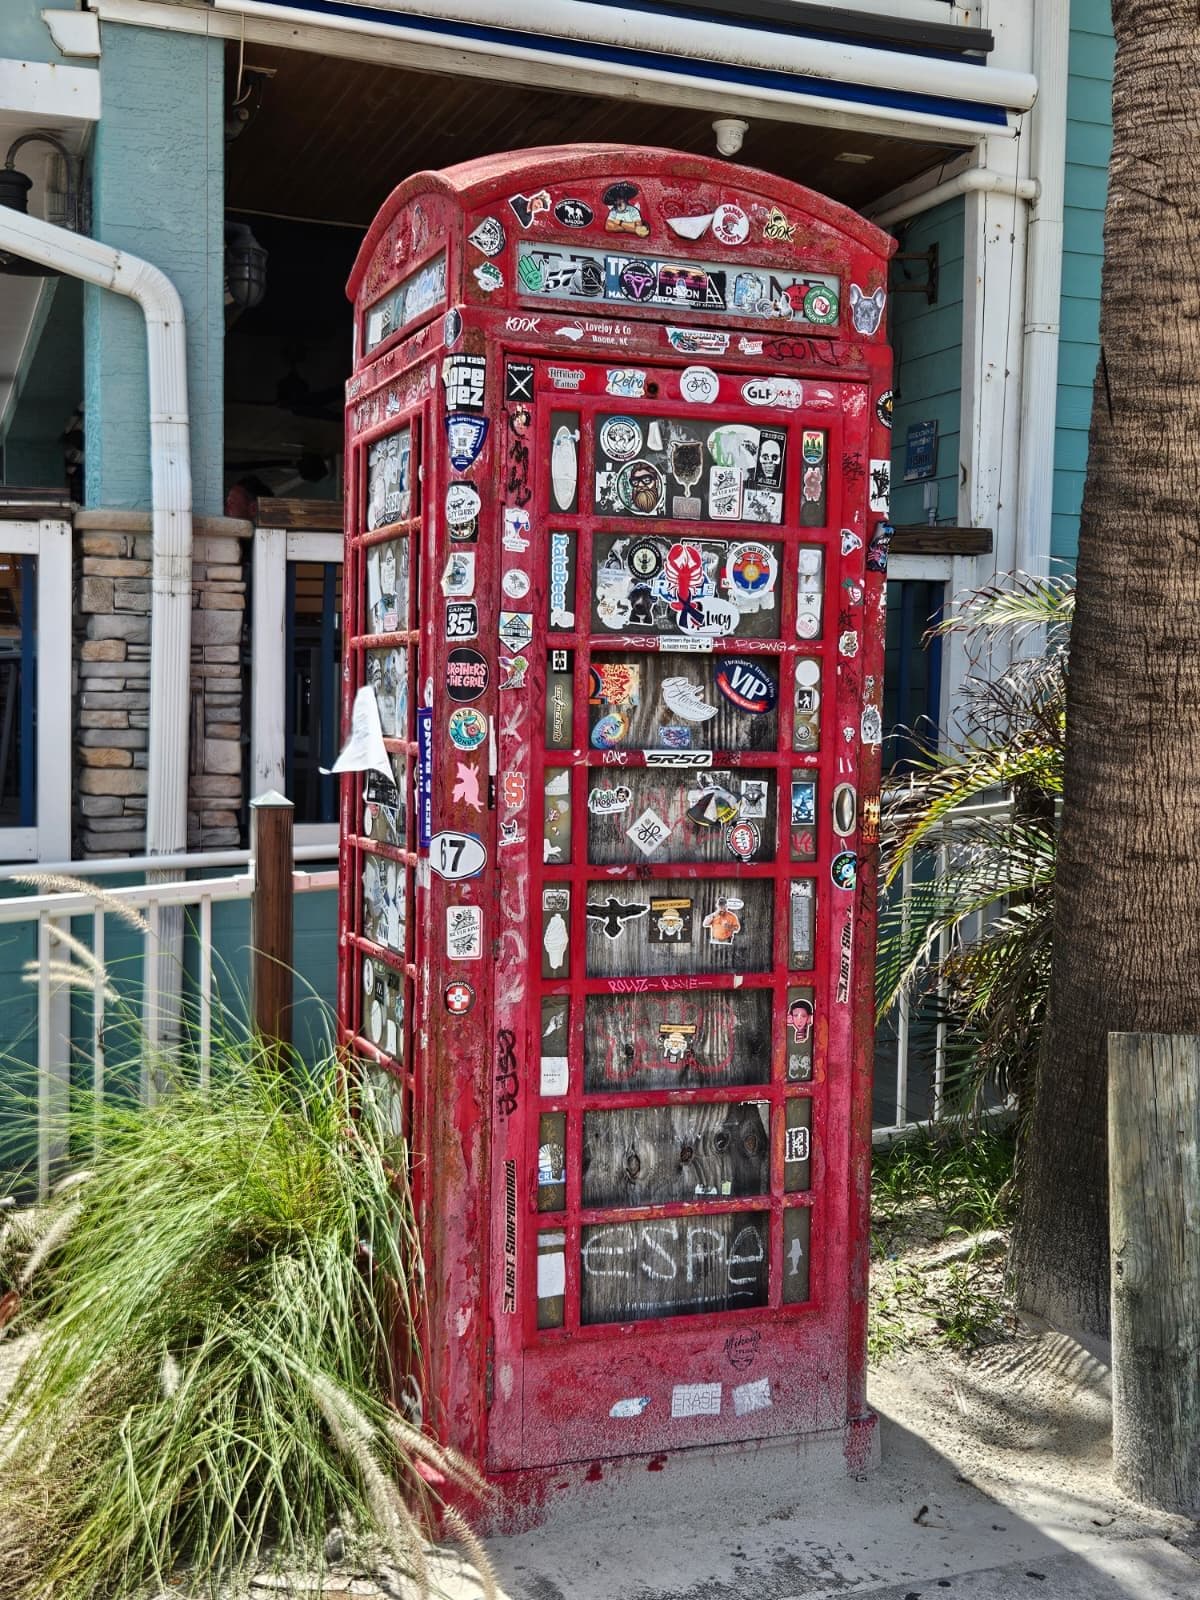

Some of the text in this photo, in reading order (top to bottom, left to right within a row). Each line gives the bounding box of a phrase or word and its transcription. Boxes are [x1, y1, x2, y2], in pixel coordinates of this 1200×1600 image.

[505, 317, 541, 333] KOOK
[552, 534, 570, 610] RateBeer
[706, 611, 731, 630] Lucy
[463, 676, 485, 688] GRILL
[731, 665, 767, 700] VIP
[423, 718, 432, 774] BANG
[647, 754, 711, 765] SR50
[440, 838, 466, 873] 67
